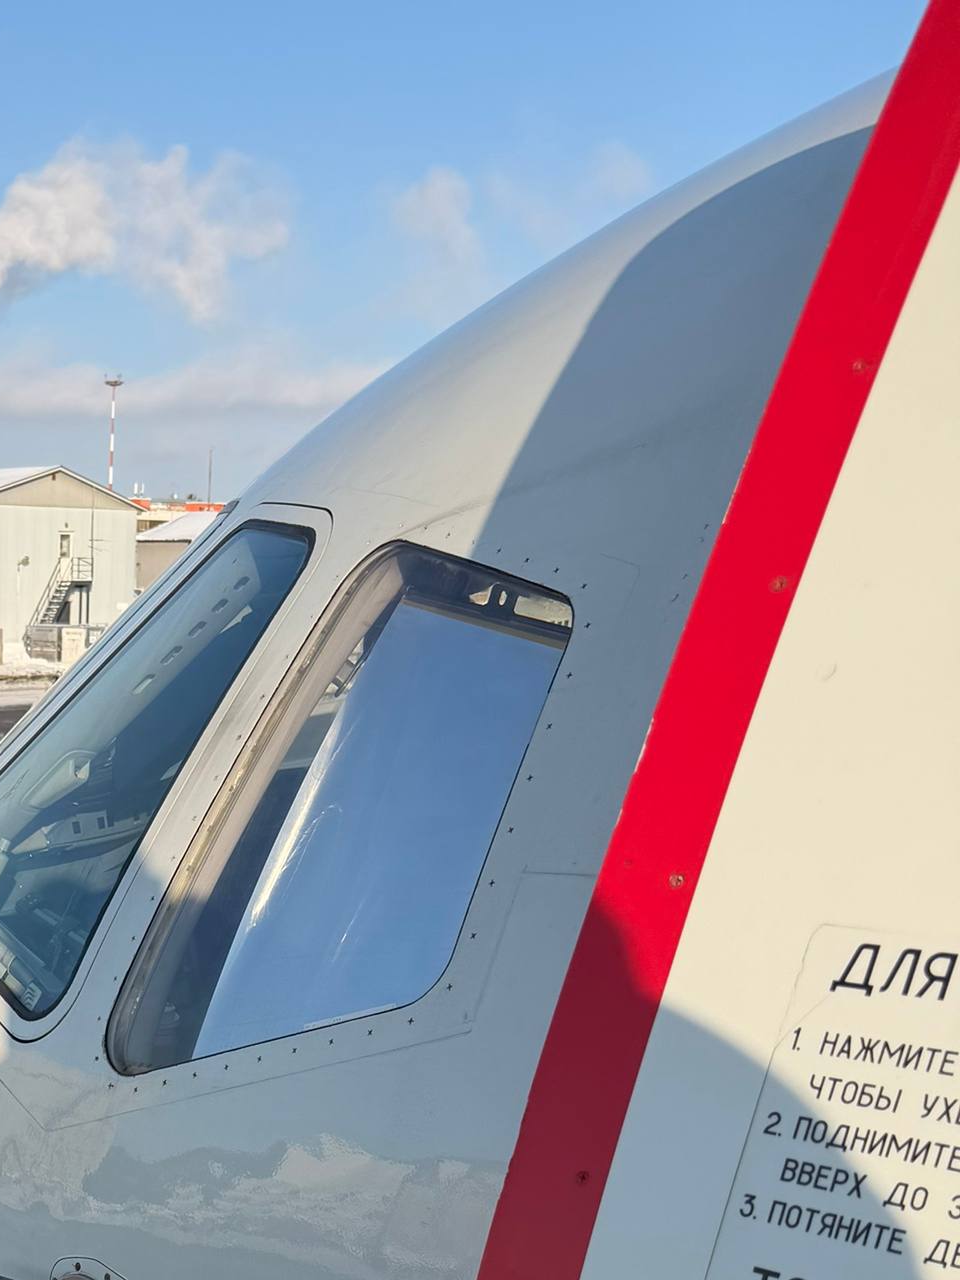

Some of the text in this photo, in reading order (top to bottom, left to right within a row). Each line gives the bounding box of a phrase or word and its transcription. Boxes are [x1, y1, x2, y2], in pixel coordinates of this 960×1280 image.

[830, 943, 958, 1001] ДЛЯ
[792, 1027, 959, 1076] 1. НАЖМИТЕ
[810, 1074, 960, 1125] ЧТОБЫ УХ
[793, 1116, 960, 1173] ПОДНИМИТЕ
[780, 1158, 867, 1199] ВВЕРХ
[882, 1182, 928, 1211] ДО
[767, 1200, 906, 1255] ПОТЯНИТЕ
